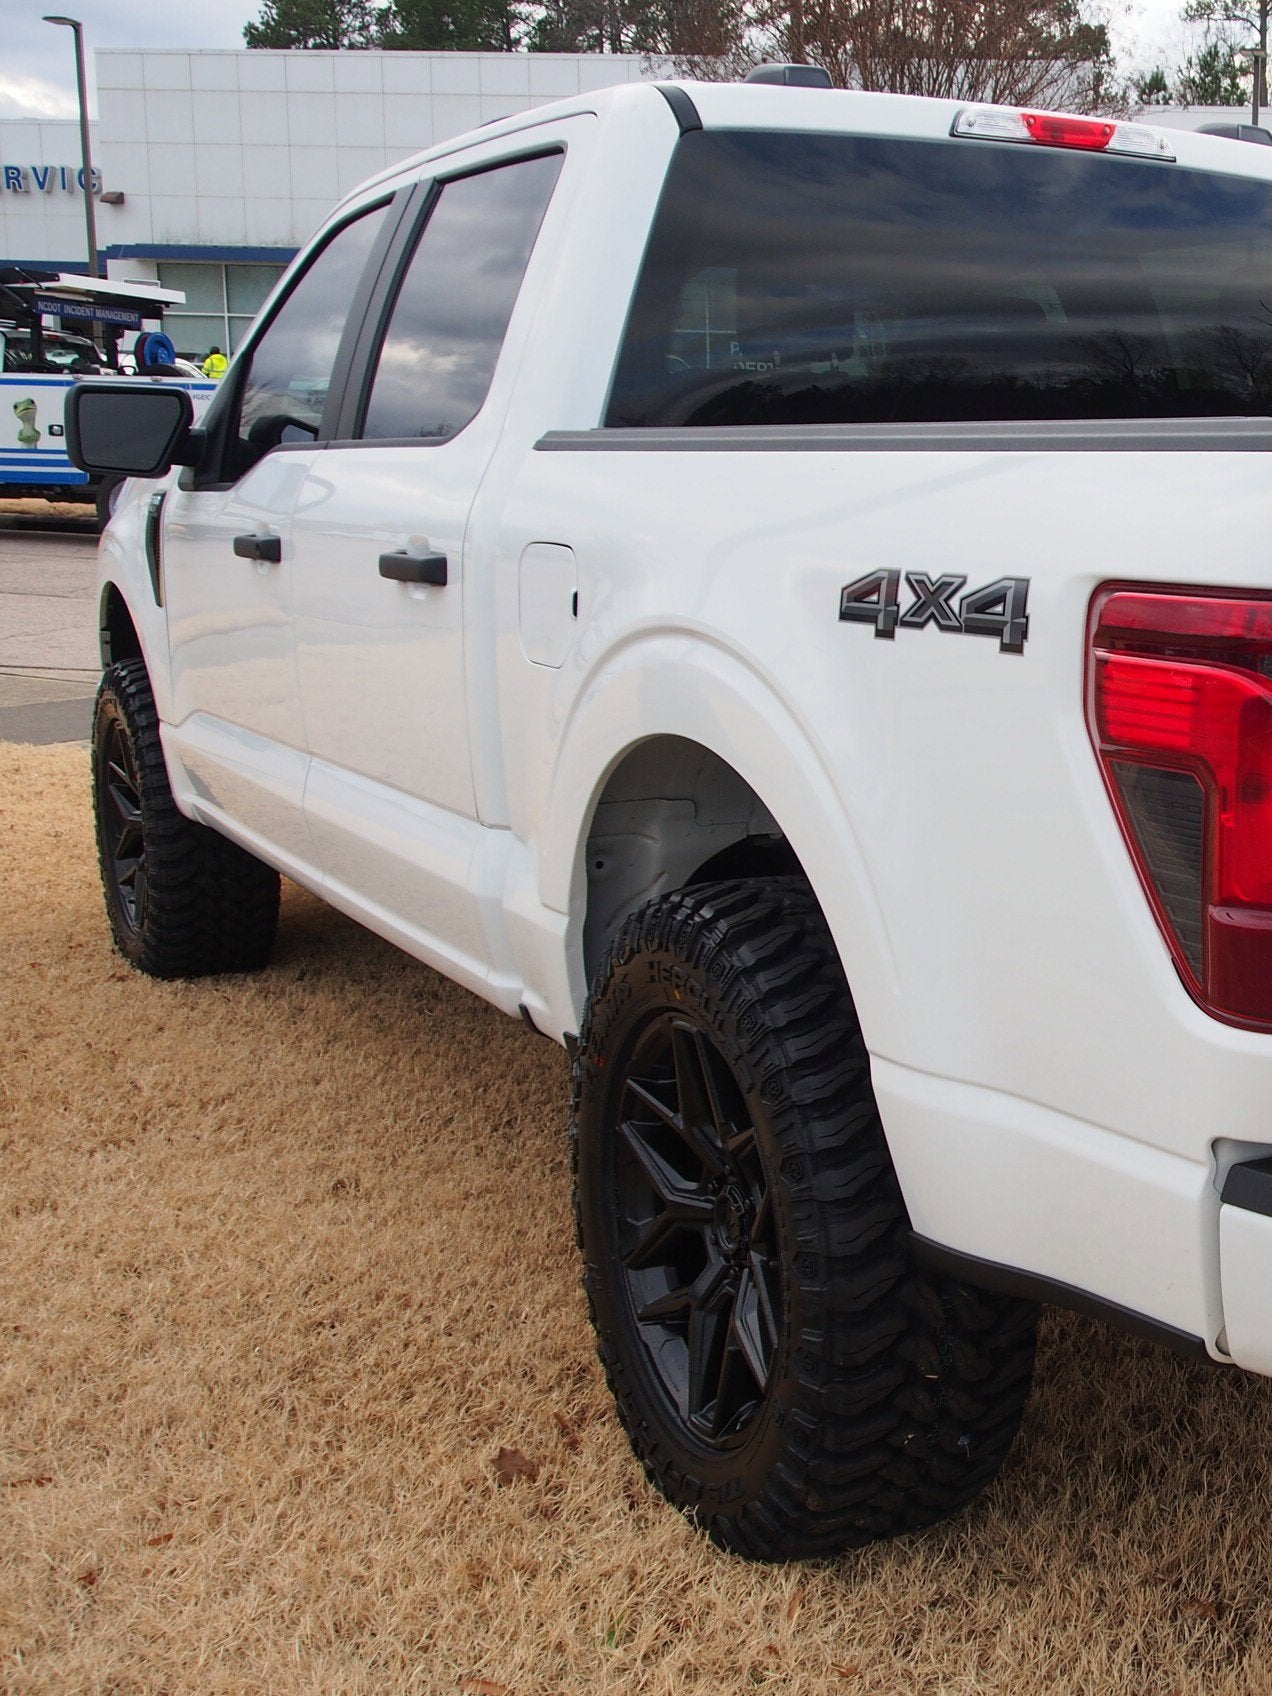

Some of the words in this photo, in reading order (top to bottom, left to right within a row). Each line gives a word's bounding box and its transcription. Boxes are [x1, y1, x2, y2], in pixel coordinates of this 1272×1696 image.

[63, 304, 95, 317] INCIDENT
[95, 308, 140, 323] MANAGEMENT
[838, 567, 1031, 657] 4X4
